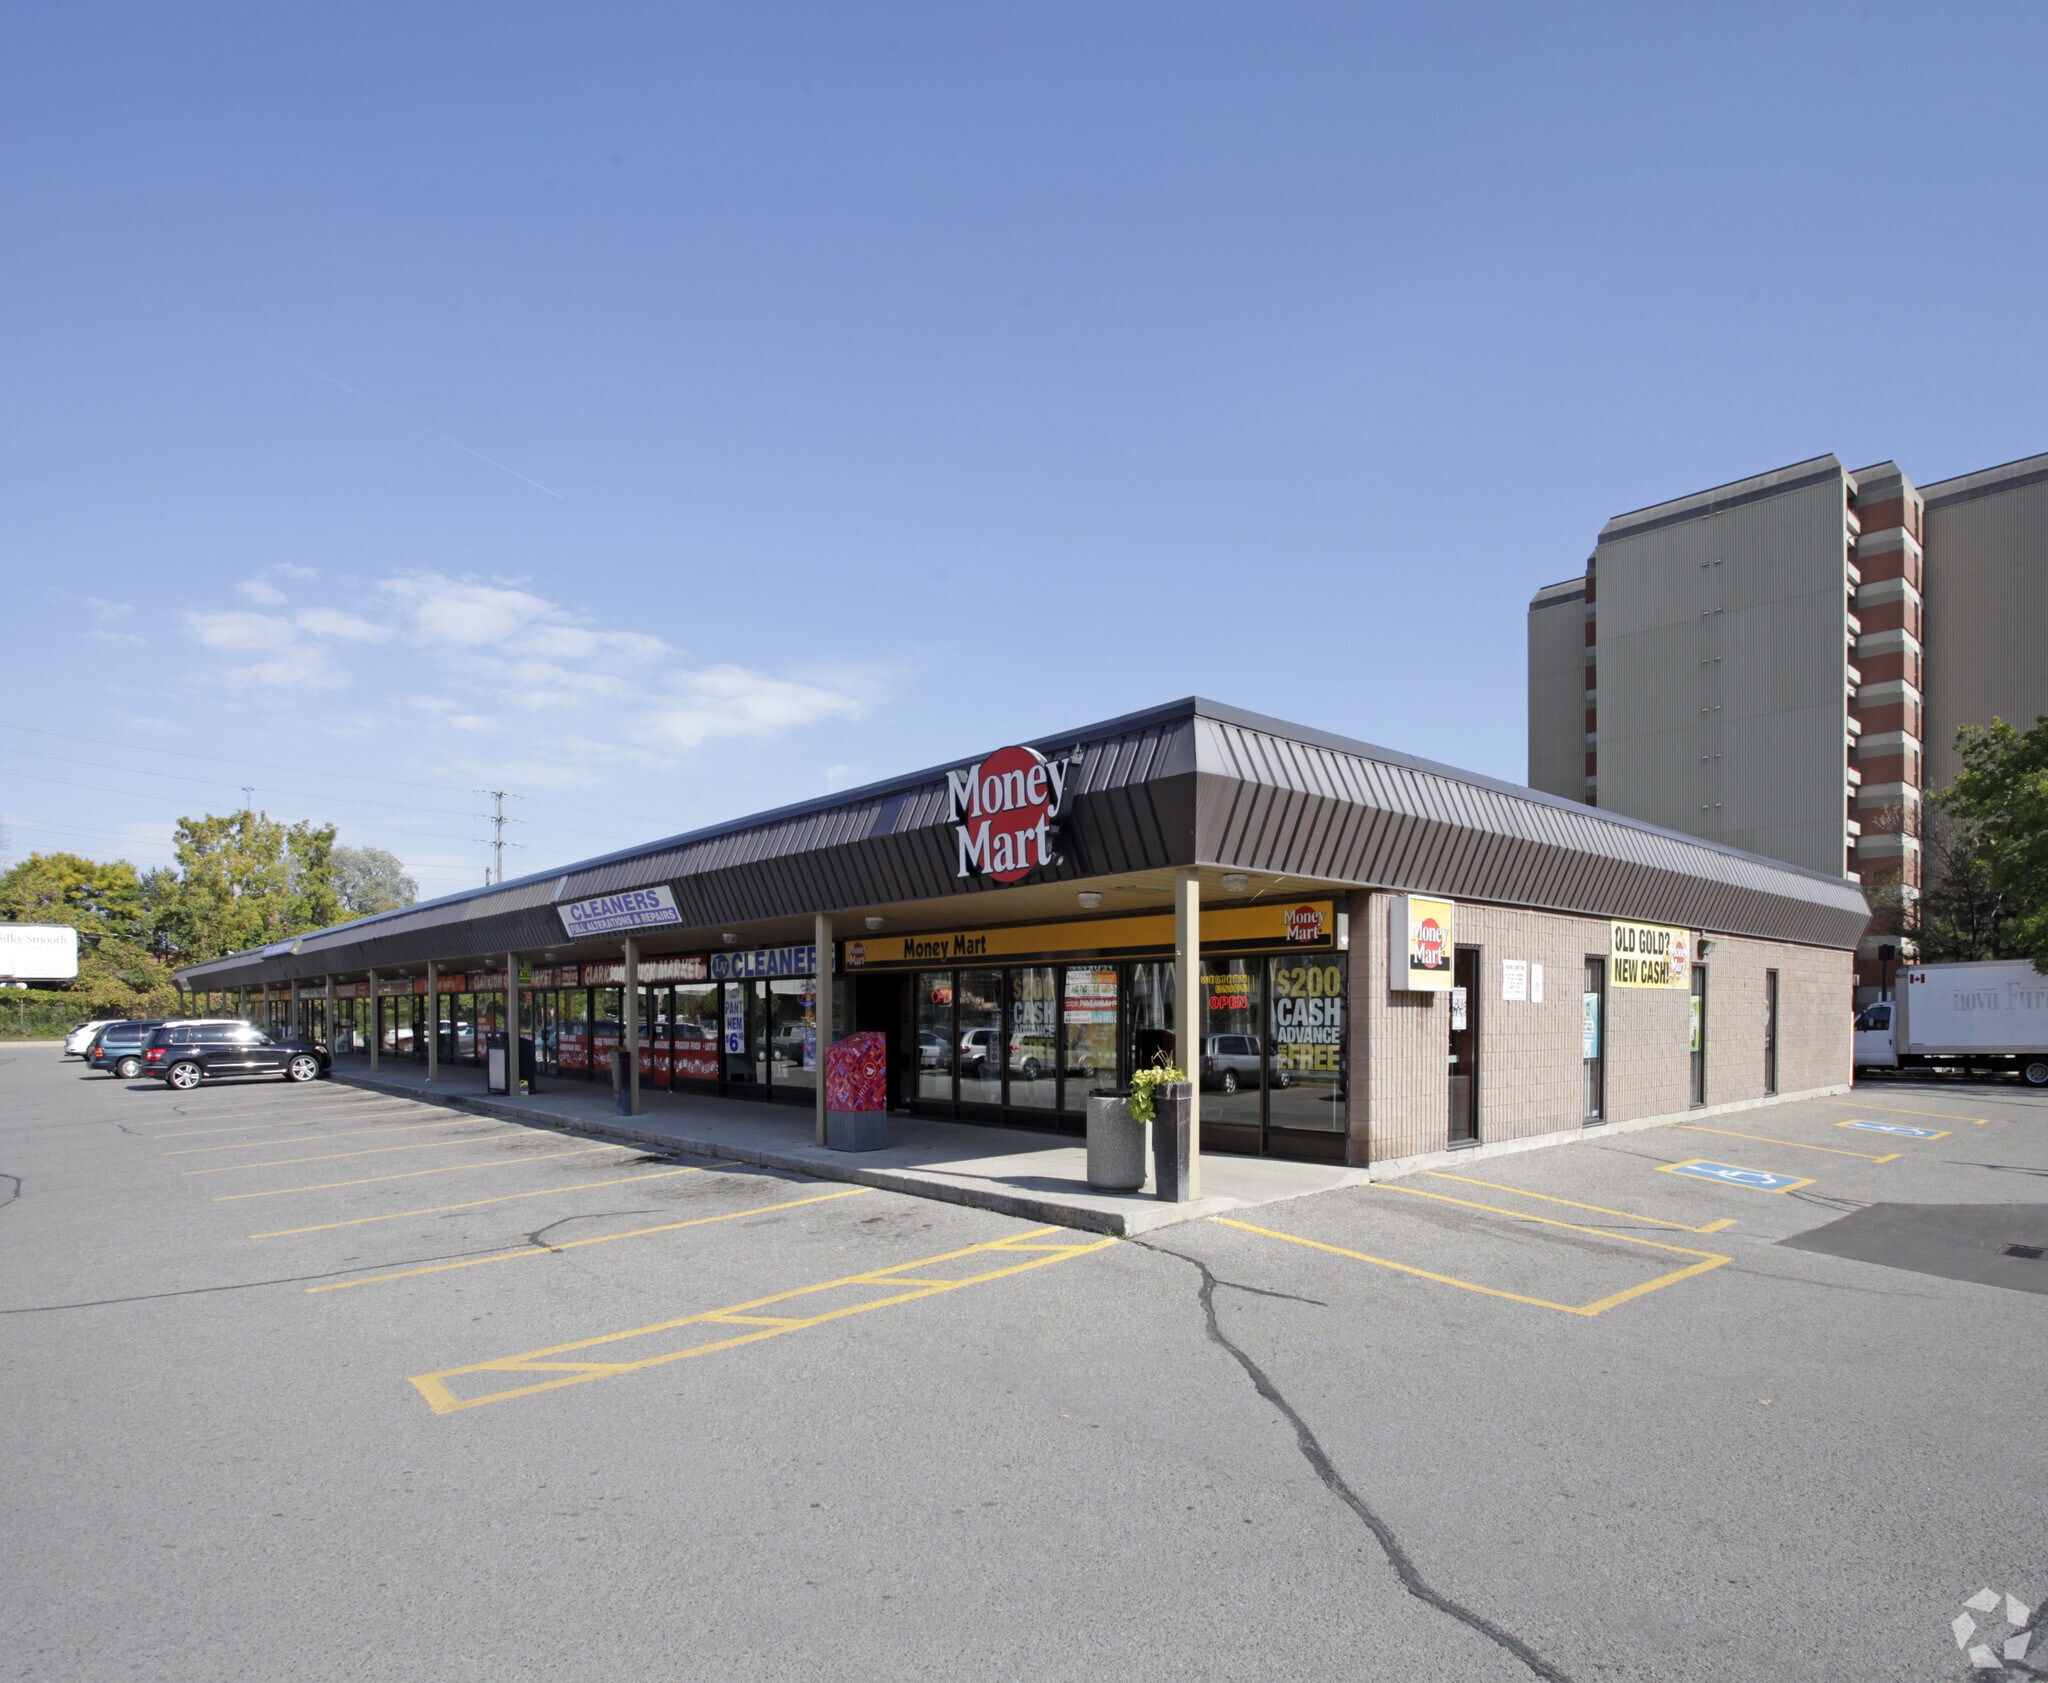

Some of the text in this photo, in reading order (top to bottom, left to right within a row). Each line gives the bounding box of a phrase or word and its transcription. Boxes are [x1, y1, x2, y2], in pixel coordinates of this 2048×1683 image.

[946, 758, 1069, 823] Money
[956, 813, 1051, 877] Mart
[570, 890, 660, 921] CLEANERS
[570, 909, 676, 933] FULL ALTERATIONS & REPAIRS
[1283, 909, 1326, 927] Money
[26, 934, 67, 944] Smooth
[1286, 925, 1319, 941] Mart
[1410, 919, 1449, 948] Money
[1615, 926, 1670, 956] OLD GOLD?
[904, 935, 986, 962] Money Mart
[1414, 942, 1443, 965] Mart
[585, 963, 627, 985] CLARKSON
[658, 957, 702, 980] MARKET
[732, 946, 834, 977] CLEANER
[1615, 958, 1669, 984] NEW CASH!
[1201, 974, 1247, 984] WESTERN
[1215, 984, 1247, 993] UNION
[1277, 966, 1340, 997] $200
[726, 1001, 742, 1014] PANT
[1014, 1001, 1056, 1024] CASH
[1209, 995, 1248, 1009] OPEN
[1277, 998, 1340, 1026] CASH
[728, 1017, 742, 1030] HEM
[1014, 1024, 1056, 1037] ADVANCE
[1278, 1027, 1340, 1043] ADVANCE
[1277, 1043, 1340, 1071] FOR FREE
